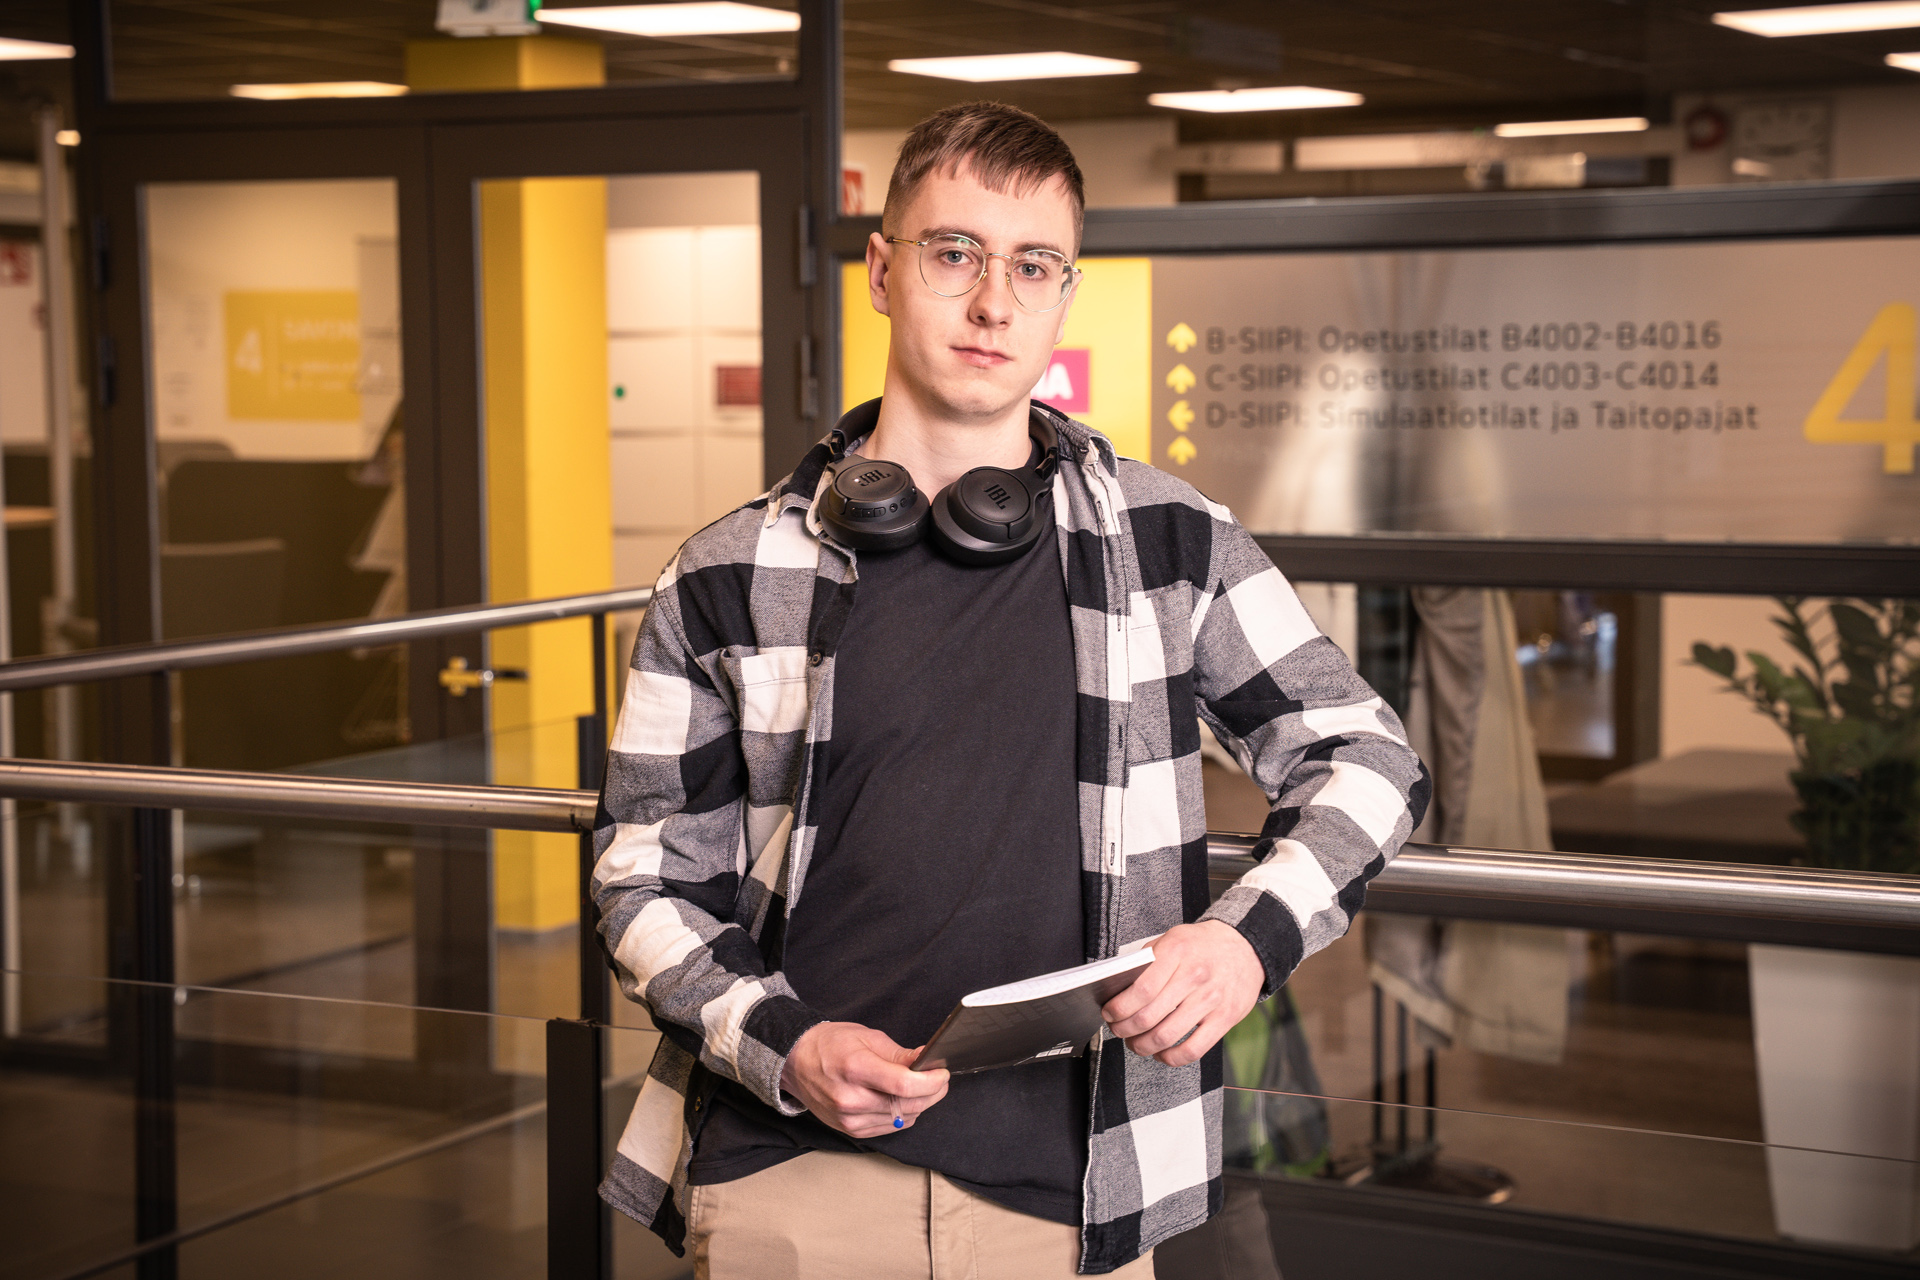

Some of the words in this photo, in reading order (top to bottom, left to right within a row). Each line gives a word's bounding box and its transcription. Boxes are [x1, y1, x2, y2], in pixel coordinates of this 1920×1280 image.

[234, 327, 263, 374] 4
[1318, 324, 1490, 354] Opetustilat
[1501, 320, 1722, 352] B4002-B4016
[1318, 362, 1490, 391] Opetustilat
[1501, 360, 1720, 391] C4003-C4014
[1804, 303, 1919, 474] 4
[1318, 400, 1540, 430] Simulaatiotilat
[1551, 401, 1580, 435] ja
[1592, 400, 1760, 435] Taitopajat
[859, 469, 892, 486] JBL
[983, 484, 1011, 510] JBL
